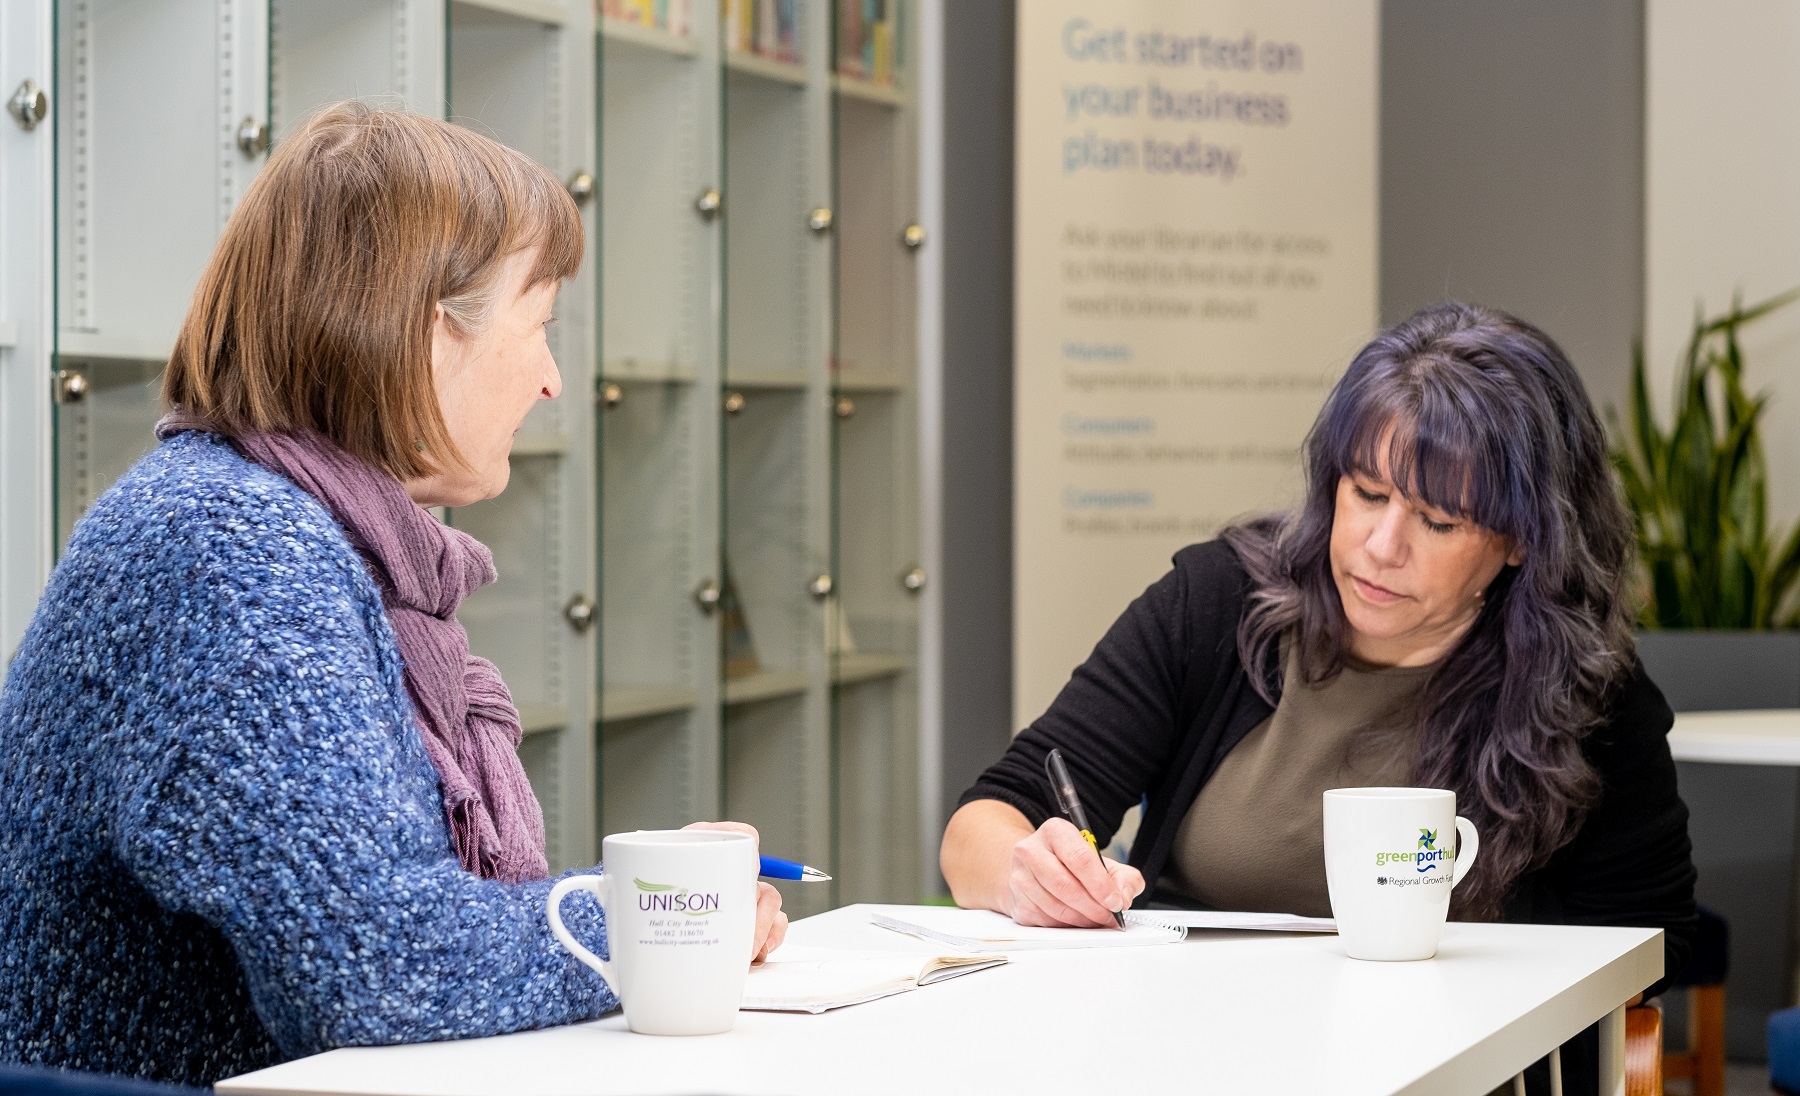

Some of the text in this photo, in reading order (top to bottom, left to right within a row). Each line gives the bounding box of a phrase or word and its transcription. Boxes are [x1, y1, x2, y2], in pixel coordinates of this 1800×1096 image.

[1061, 17, 1304, 74] Get started on
[1061, 78, 1291, 127] your business
[1061, 127, 1246, 185] plan today.
[1389, 876, 1421, 887] Regional
[1423, 874, 1445, 885] Growth
[639, 893, 719, 912] UNISON
[649, 918, 709, 928] Hull City Branch
